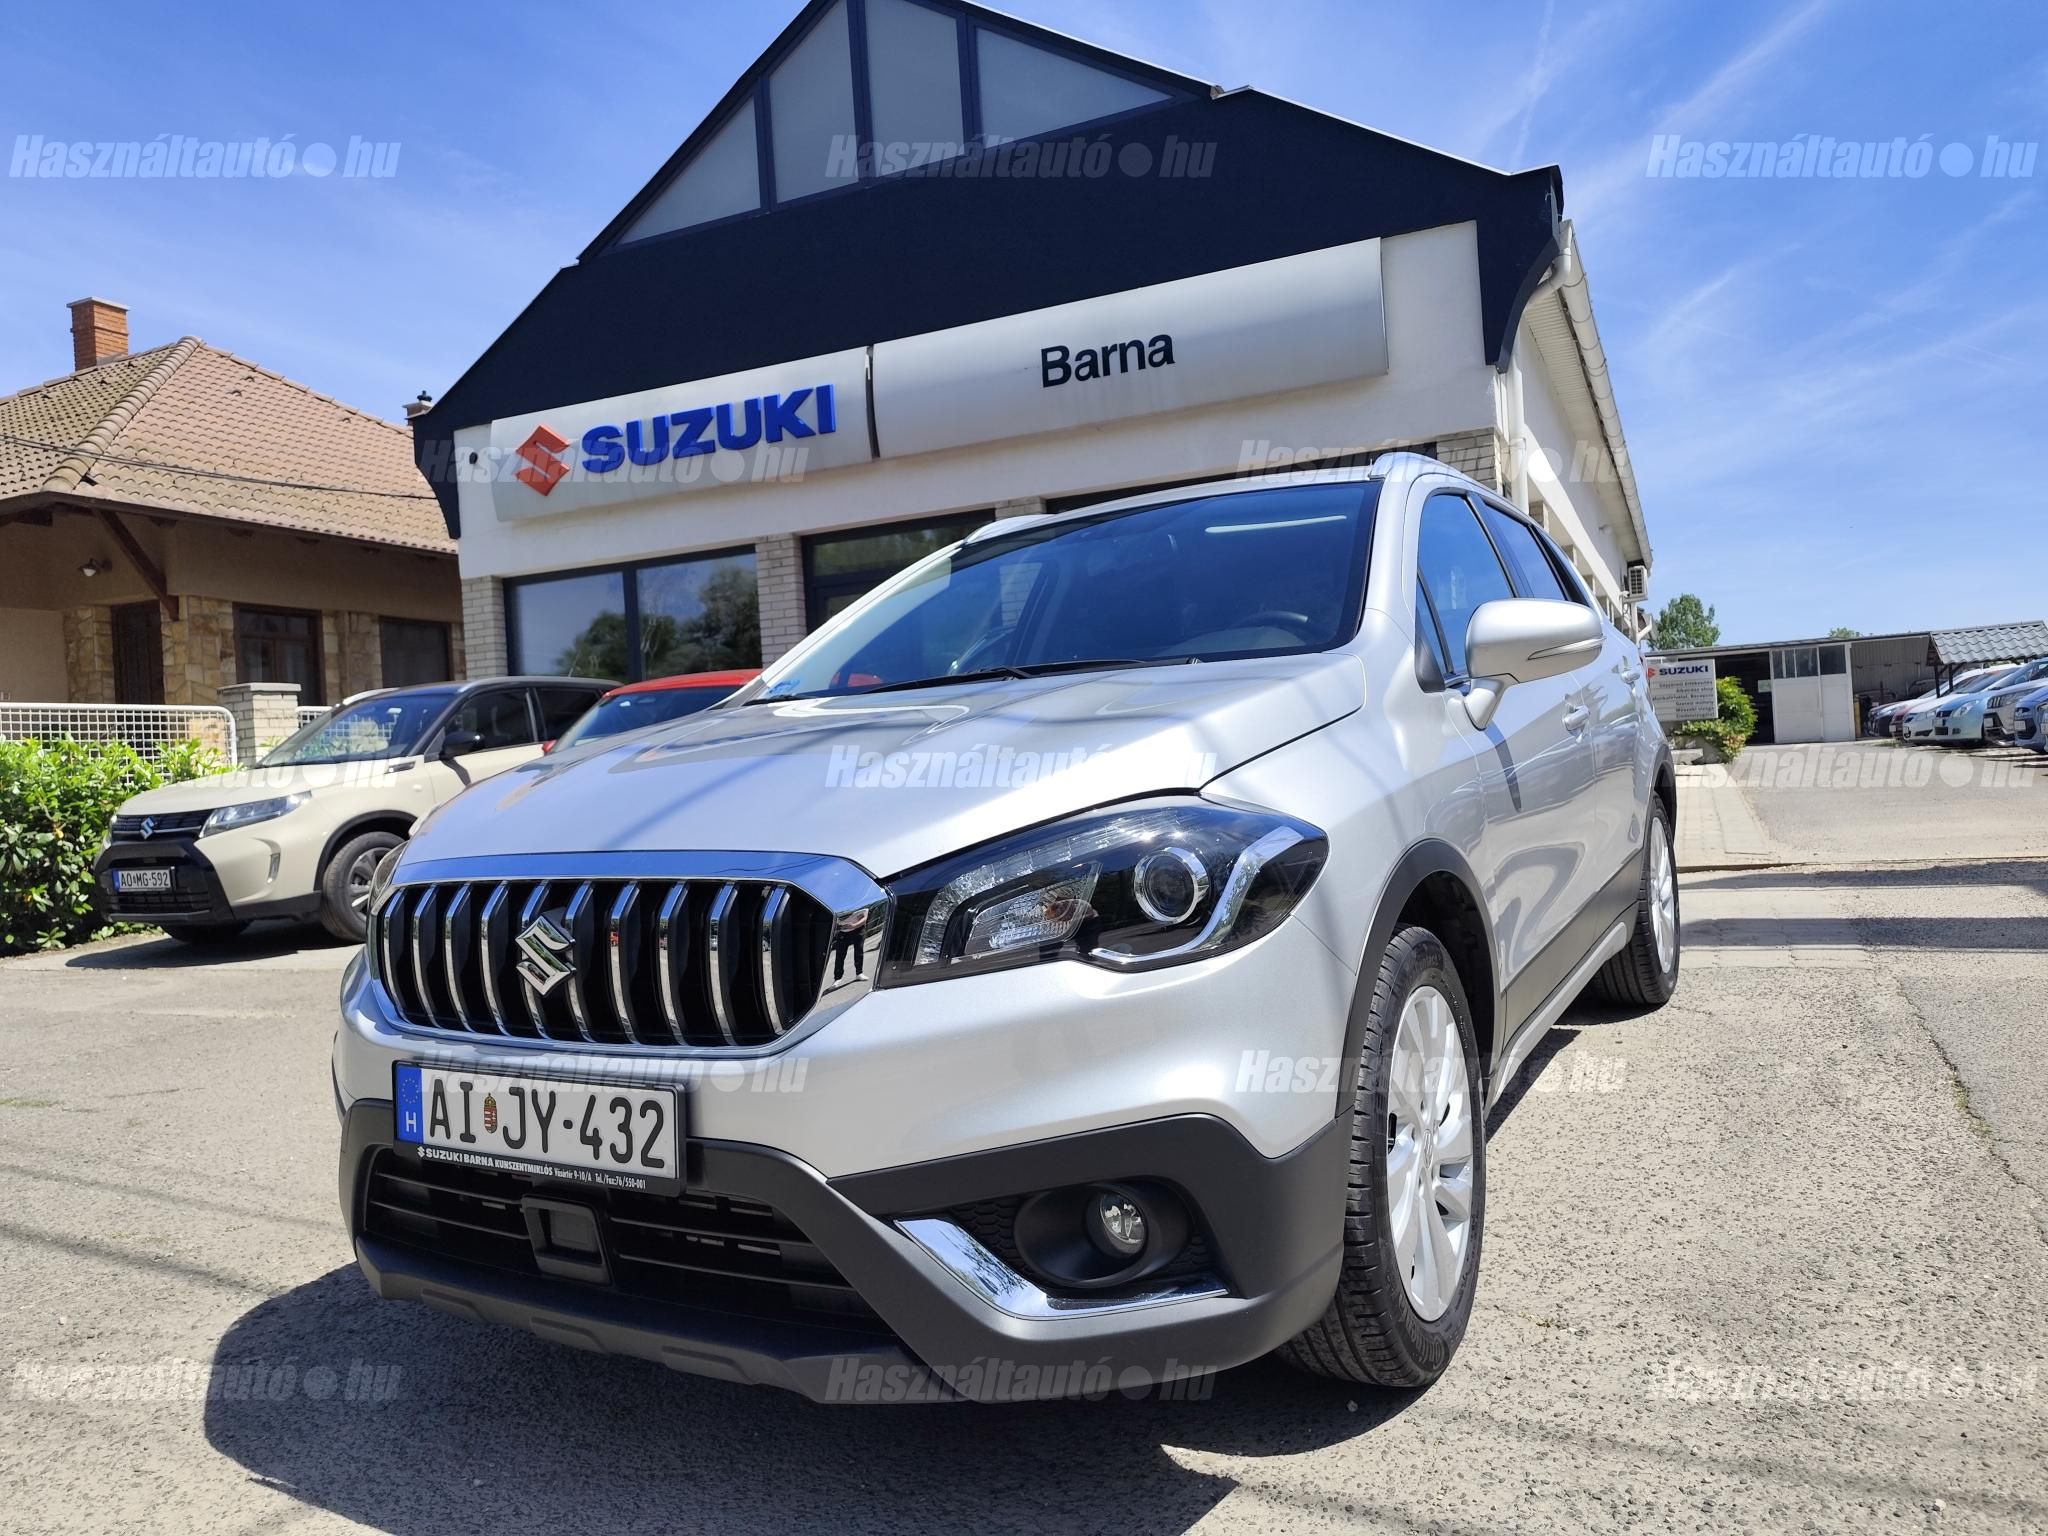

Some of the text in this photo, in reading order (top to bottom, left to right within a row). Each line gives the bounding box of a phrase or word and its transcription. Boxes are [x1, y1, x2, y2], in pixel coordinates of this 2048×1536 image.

[1041, 334, 1175, 388] Barna
[581, 383, 836, 474] SUZUKI
[1659, 665, 1709, 676] SUZUKI
[405, 1111, 417, 1133] H
[426, 1148, 463, 1163] SUZUKI
[463, 1154, 494, 1168] BARNA
[494, 1159, 553, 1176] KUNSZENTMIKLÓS
[574, 1170, 592, 1182] 9-10/A
